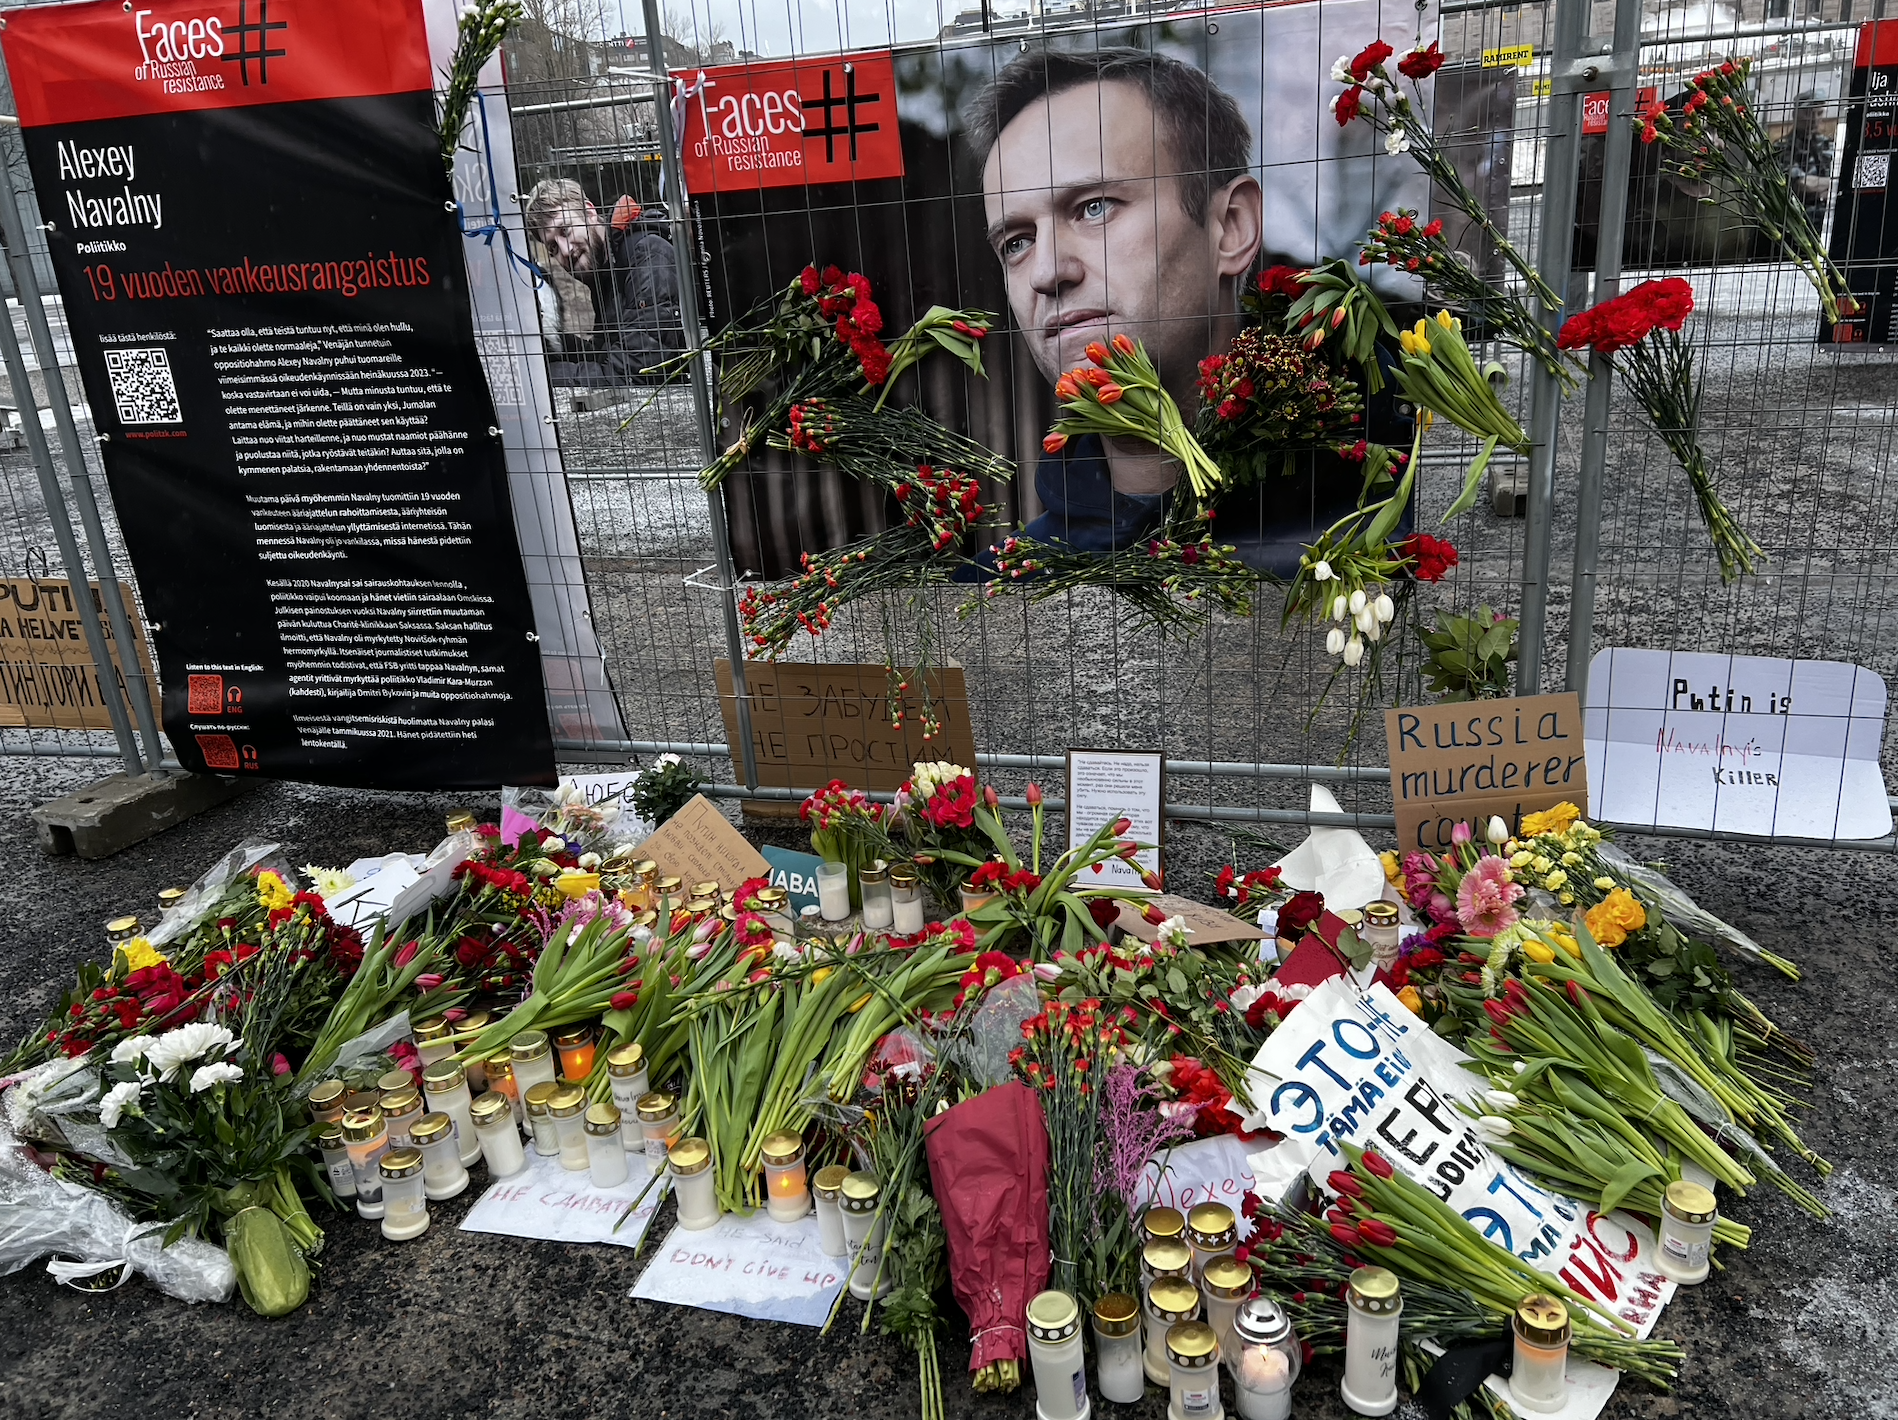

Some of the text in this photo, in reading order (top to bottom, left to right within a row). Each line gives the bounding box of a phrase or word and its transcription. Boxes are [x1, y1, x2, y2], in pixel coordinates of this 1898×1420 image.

[134, 9, 225, 64] Faces
[1483, 51, 1530, 64] RAMIRENT
[134, 59, 198, 82] of Russian
[162, 72, 225, 95] resistance
[697, 81, 807, 140] Faces
[694, 134, 770, 158] of Russian
[57, 139, 135, 181] Alexey
[728, 147, 802, 173] resistance
[66, 185, 163, 230] Navalny
[76, 239, 127, 255] Poliitikko
[83, 250, 431, 302] 19 vuoden vankeusrangaistus
[118, 332, 136, 342] tästä
[240, 327, 258, 336] olla,
[257, 326, 273, 335] että
[273, 325, 295, 334] teistä
[295, 325, 322, 334] tuntuu
[322, 325, 338, 334] nyt,
[337, 324, 353, 332] että
[353, 323, 372, 332] minä
[372, 323, 390, 332] olen
[389, 322, 413, 331] hullu,
[210, 344, 218, 355] ja
[218, 345, 227, 353] te
[227, 343, 251, 352] kaikki
[251, 343, 274, 351] olette
[322, 339, 354, 350] Venäjän
[354, 339, 392, 347] tunnetuin
[214, 353, 402, 370] oppositiohahmo Alexey Navalny puhui tuomareille
[221, 383, 452, 399] koska vastavirtaan ei voi uida, Mutta minusta tuntuu, että te
[258, 419, 284, 429] elämä,
[283, 419, 292, 430] ja
[292, 418, 315, 427] mihin
[315, 418, 338, 427] olette
[338, 417, 380, 428] päättäneet
[394, 415, 428, 426] käyttää?
[238, 466, 281, 475] kymmenen
[281, 464, 314, 474] palatsia,
[314, 464, 363, 472] rakentamaan
[279, 494, 300, 504] päivä
[300, 493, 350, 503] myöhemmin
[350, 492, 381, 502] Navalny
[381, 492, 419, 501] tuomittiin
[420, 492, 430, 500] 19
[430, 491, 460, 500] vuoden
[1672, 678, 1793, 714] Putin is
[226, 705, 243, 714] ENG
[1399, 708, 1569, 753] Russia
[806, 732, 955, 768] ПРОСТИМ
[1402, 754, 1584, 800] murderer
[1270, 1019, 1381, 1133] ЭТО
[1315, 1077, 1385, 1157] TÄMÄ
